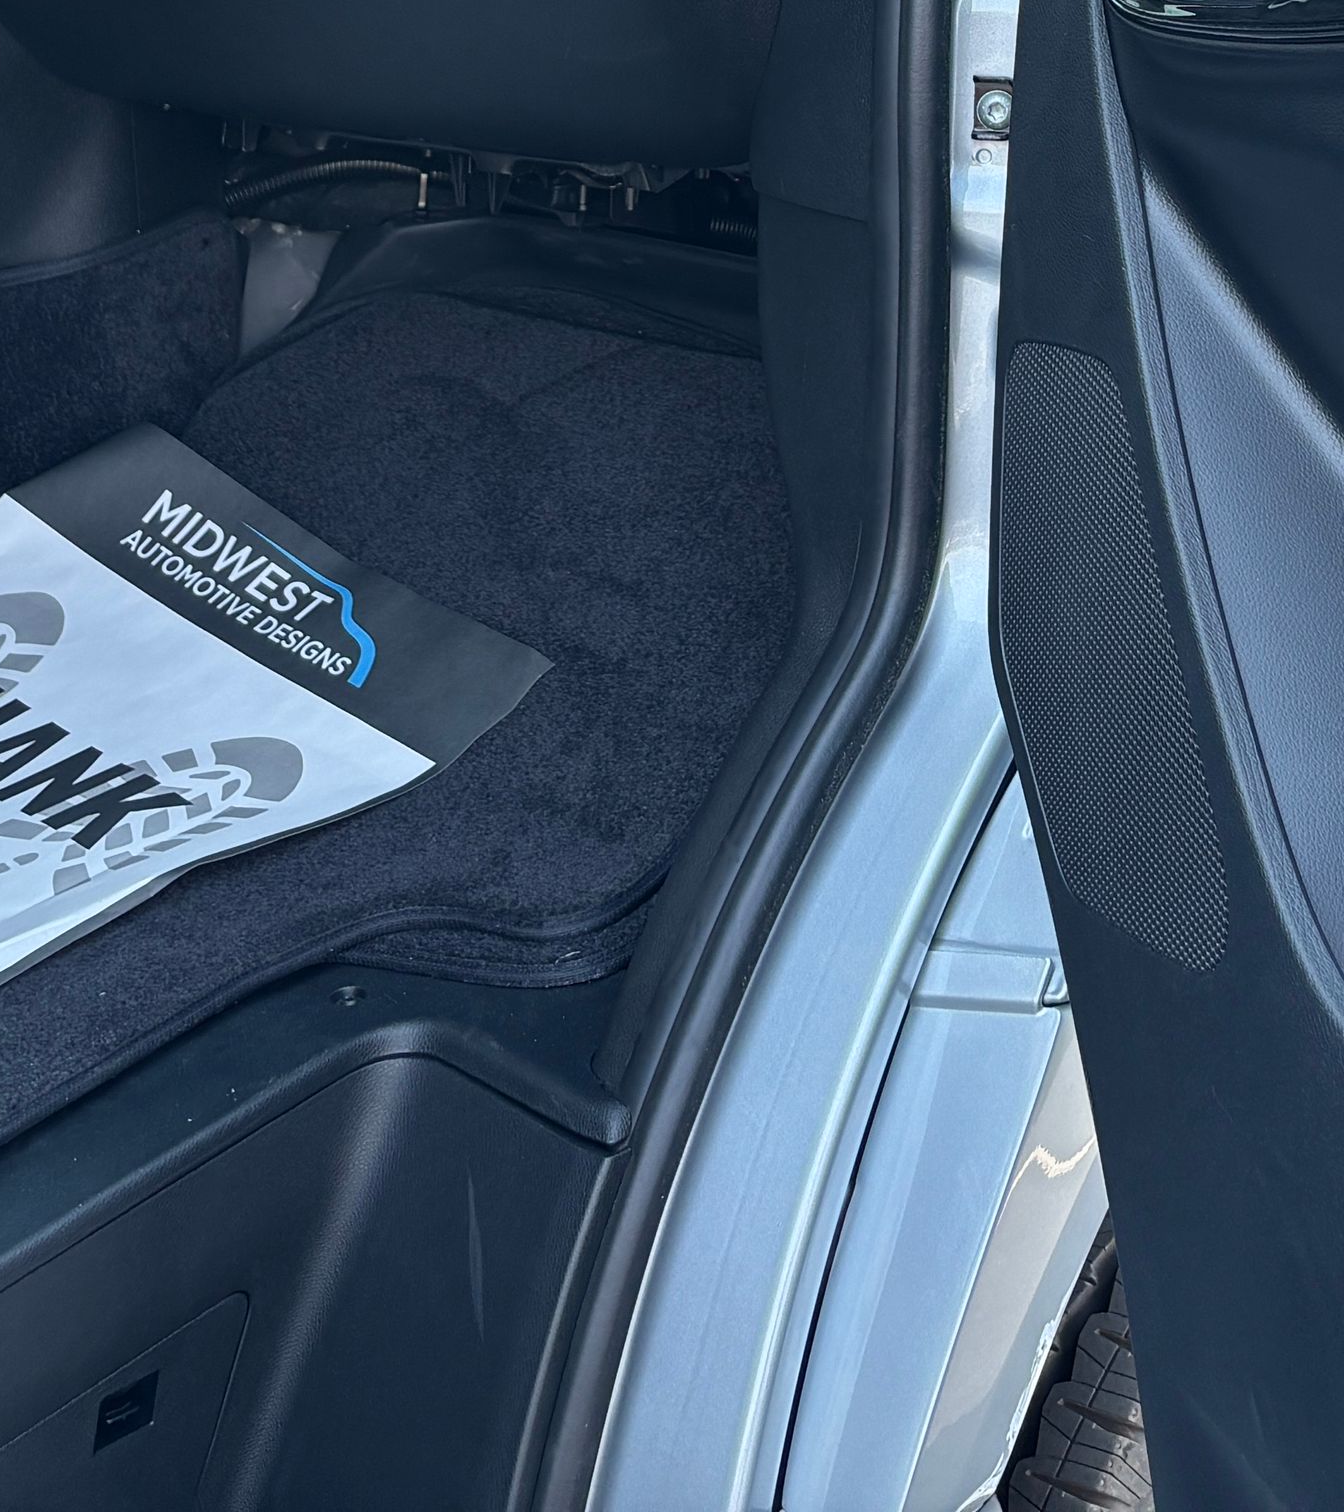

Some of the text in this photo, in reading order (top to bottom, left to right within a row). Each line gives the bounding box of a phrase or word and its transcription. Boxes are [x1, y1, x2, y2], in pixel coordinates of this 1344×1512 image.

[120, 529, 353, 677] AUTOMOTIVE DESIGNS
[141, 489, 334, 623] MIDWEST
